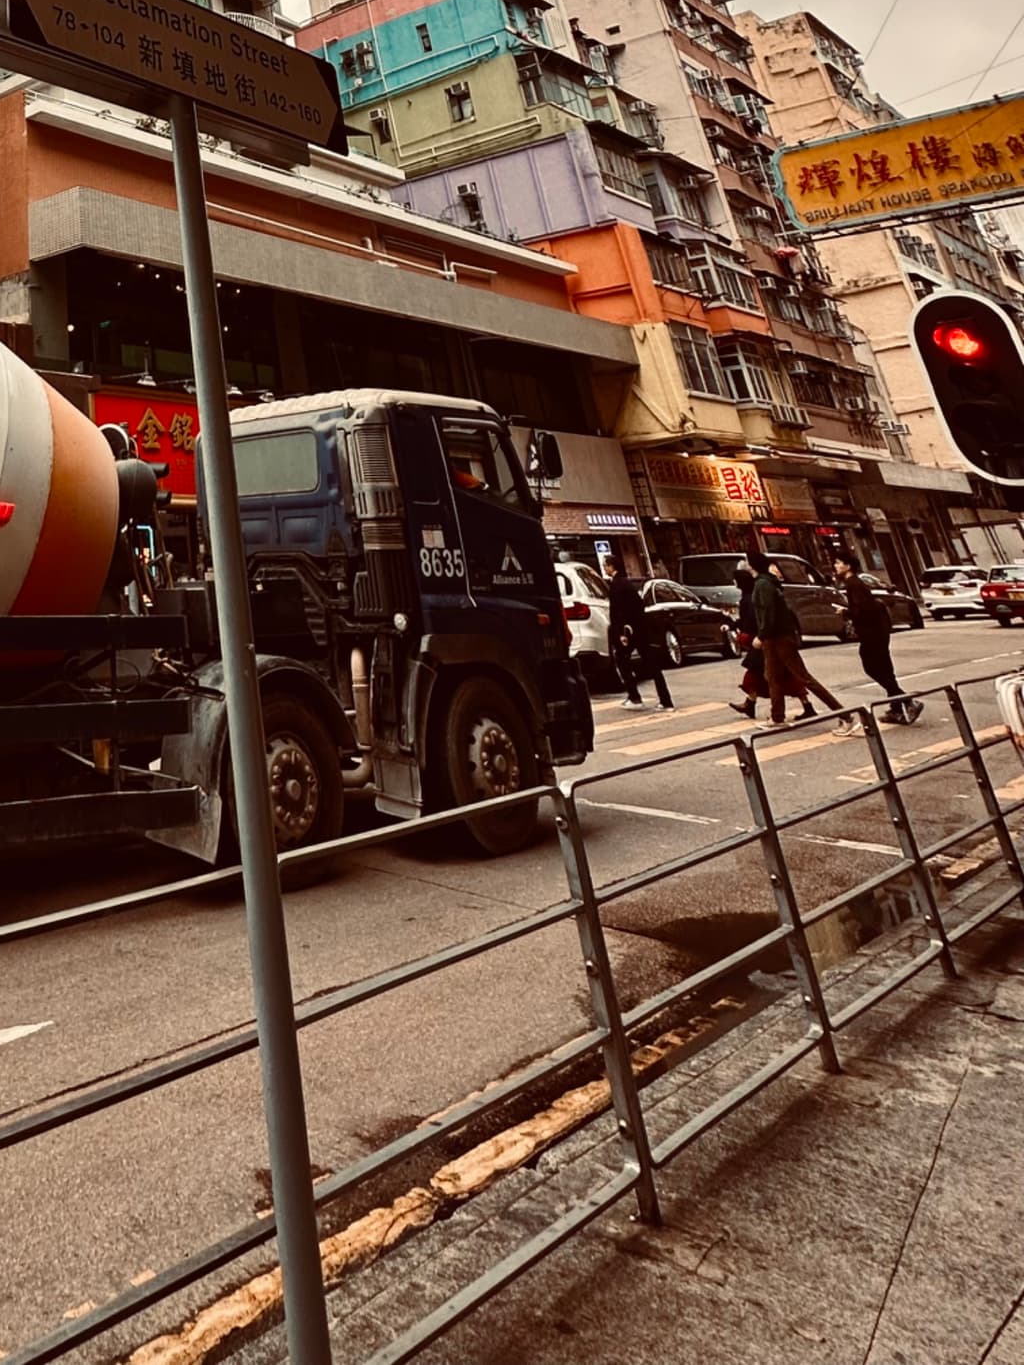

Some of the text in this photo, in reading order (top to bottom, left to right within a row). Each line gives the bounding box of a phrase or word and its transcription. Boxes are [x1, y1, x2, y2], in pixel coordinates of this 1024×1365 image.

[137, 34, 258, 107] 新填地街
[228, 32, 290, 78] Street
[805, 200, 874, 224] BRILLIANT
[880, 189, 932, 209] HOUSE
[939, 173, 1015, 197] SEAFOOD
[420, 549, 464, 577] 8635
